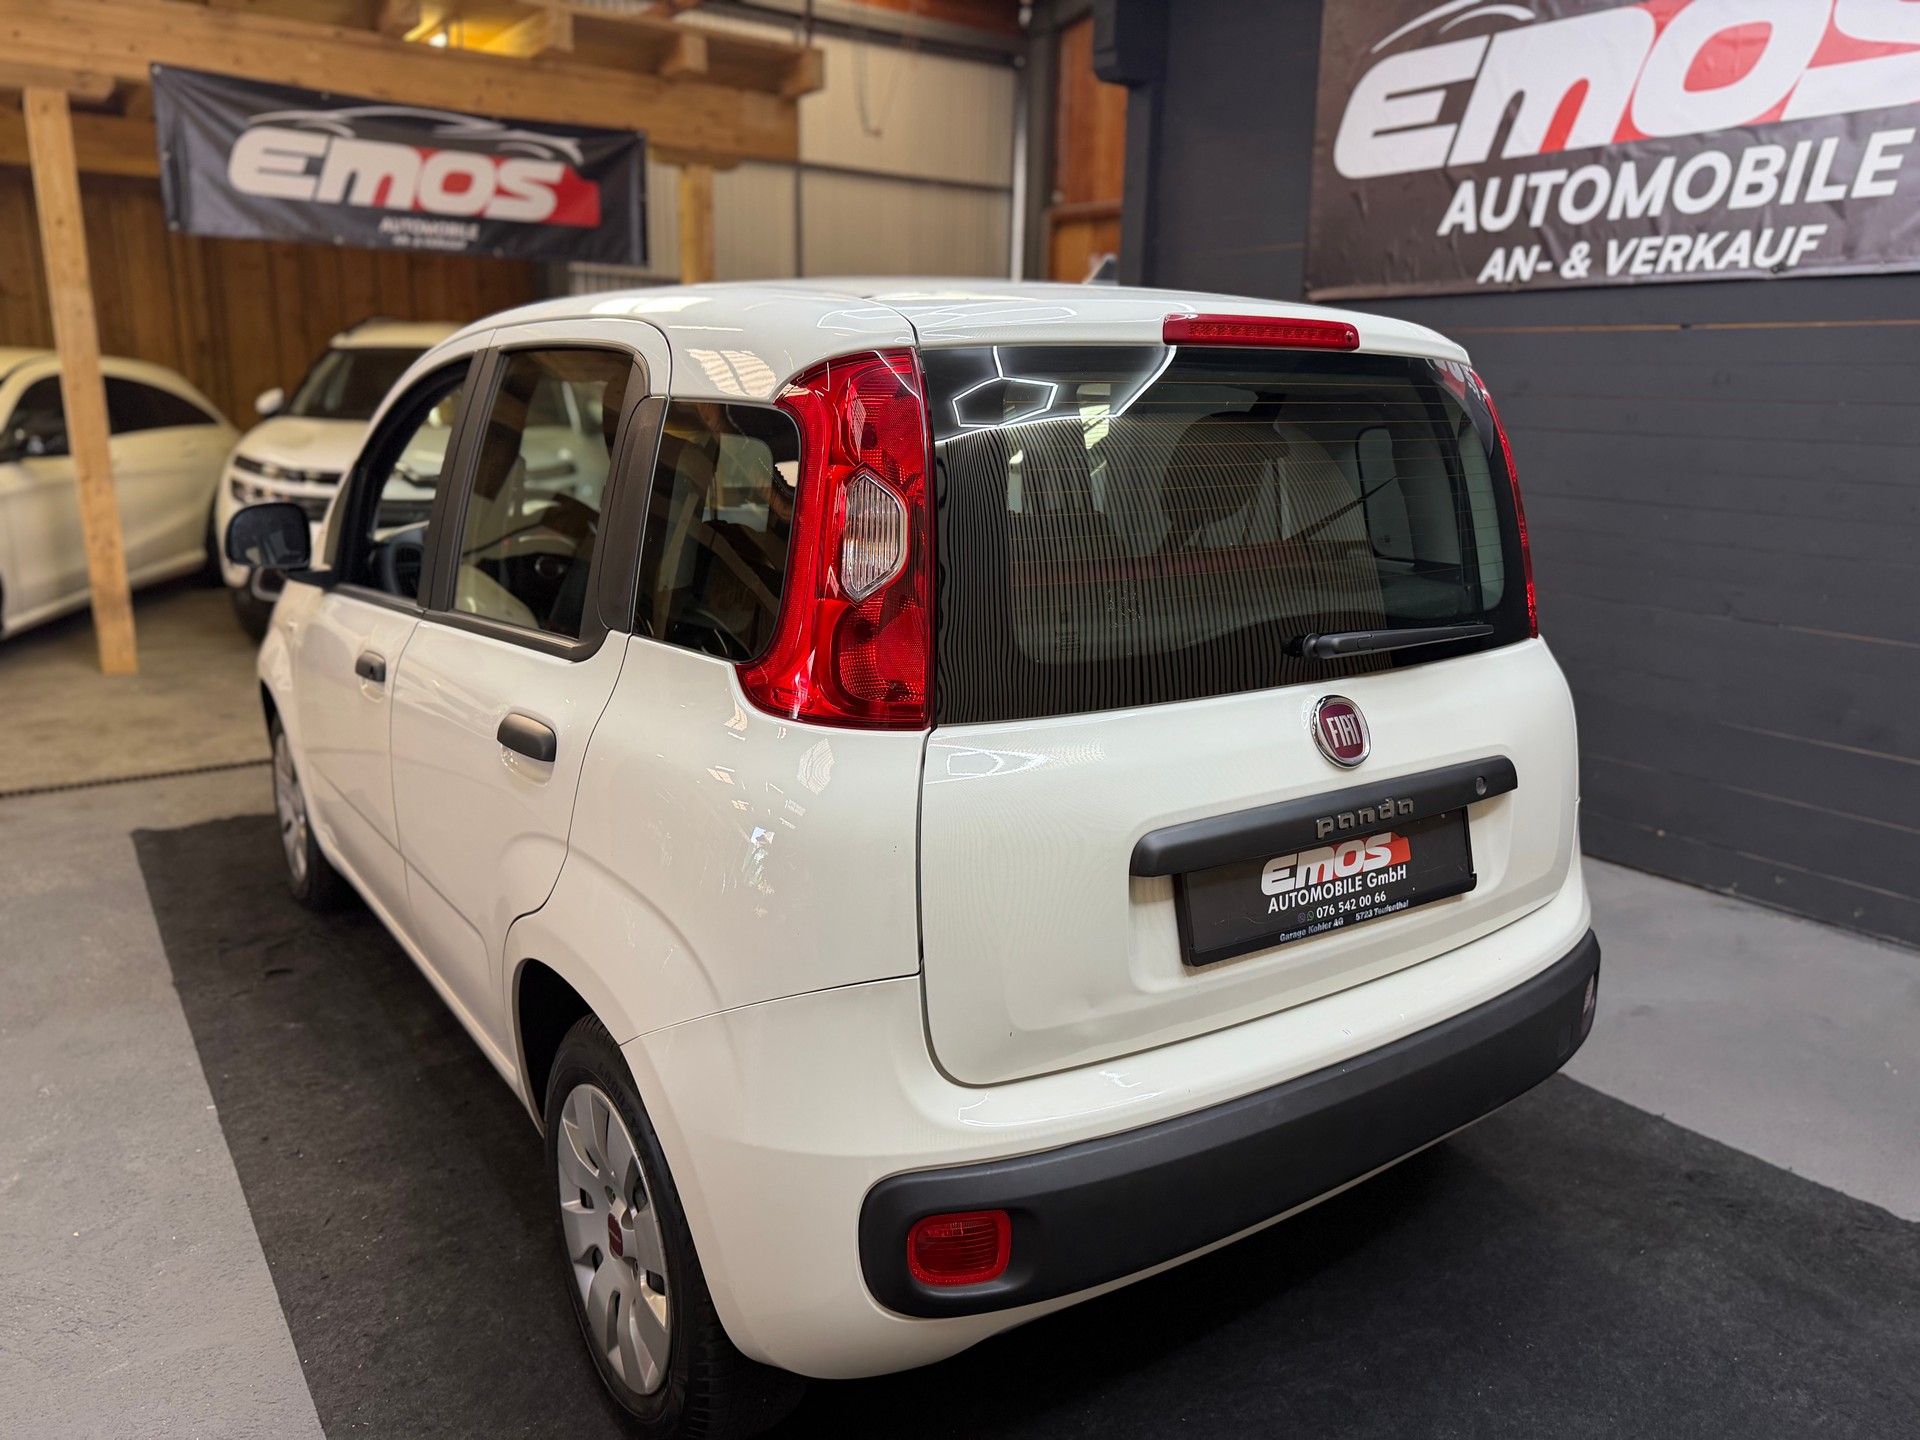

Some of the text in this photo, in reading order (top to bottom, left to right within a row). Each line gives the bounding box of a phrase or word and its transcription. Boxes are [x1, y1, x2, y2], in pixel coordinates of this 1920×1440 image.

[1436, 128, 1917, 237] AUTOMOBILE
[1477, 224, 1828, 286] AN- & VERKAUF
[1326, 713, 1361, 749] FIAT
[1267, 864, 1407, 914] AUTOMOBILE GmbH
[1316, 891, 1386, 919] 076 542 00 66
[1279, 929, 1306, 942] Garage
[1333, 917, 1344, 927] AG
[1355, 909, 1373, 921] 5723
